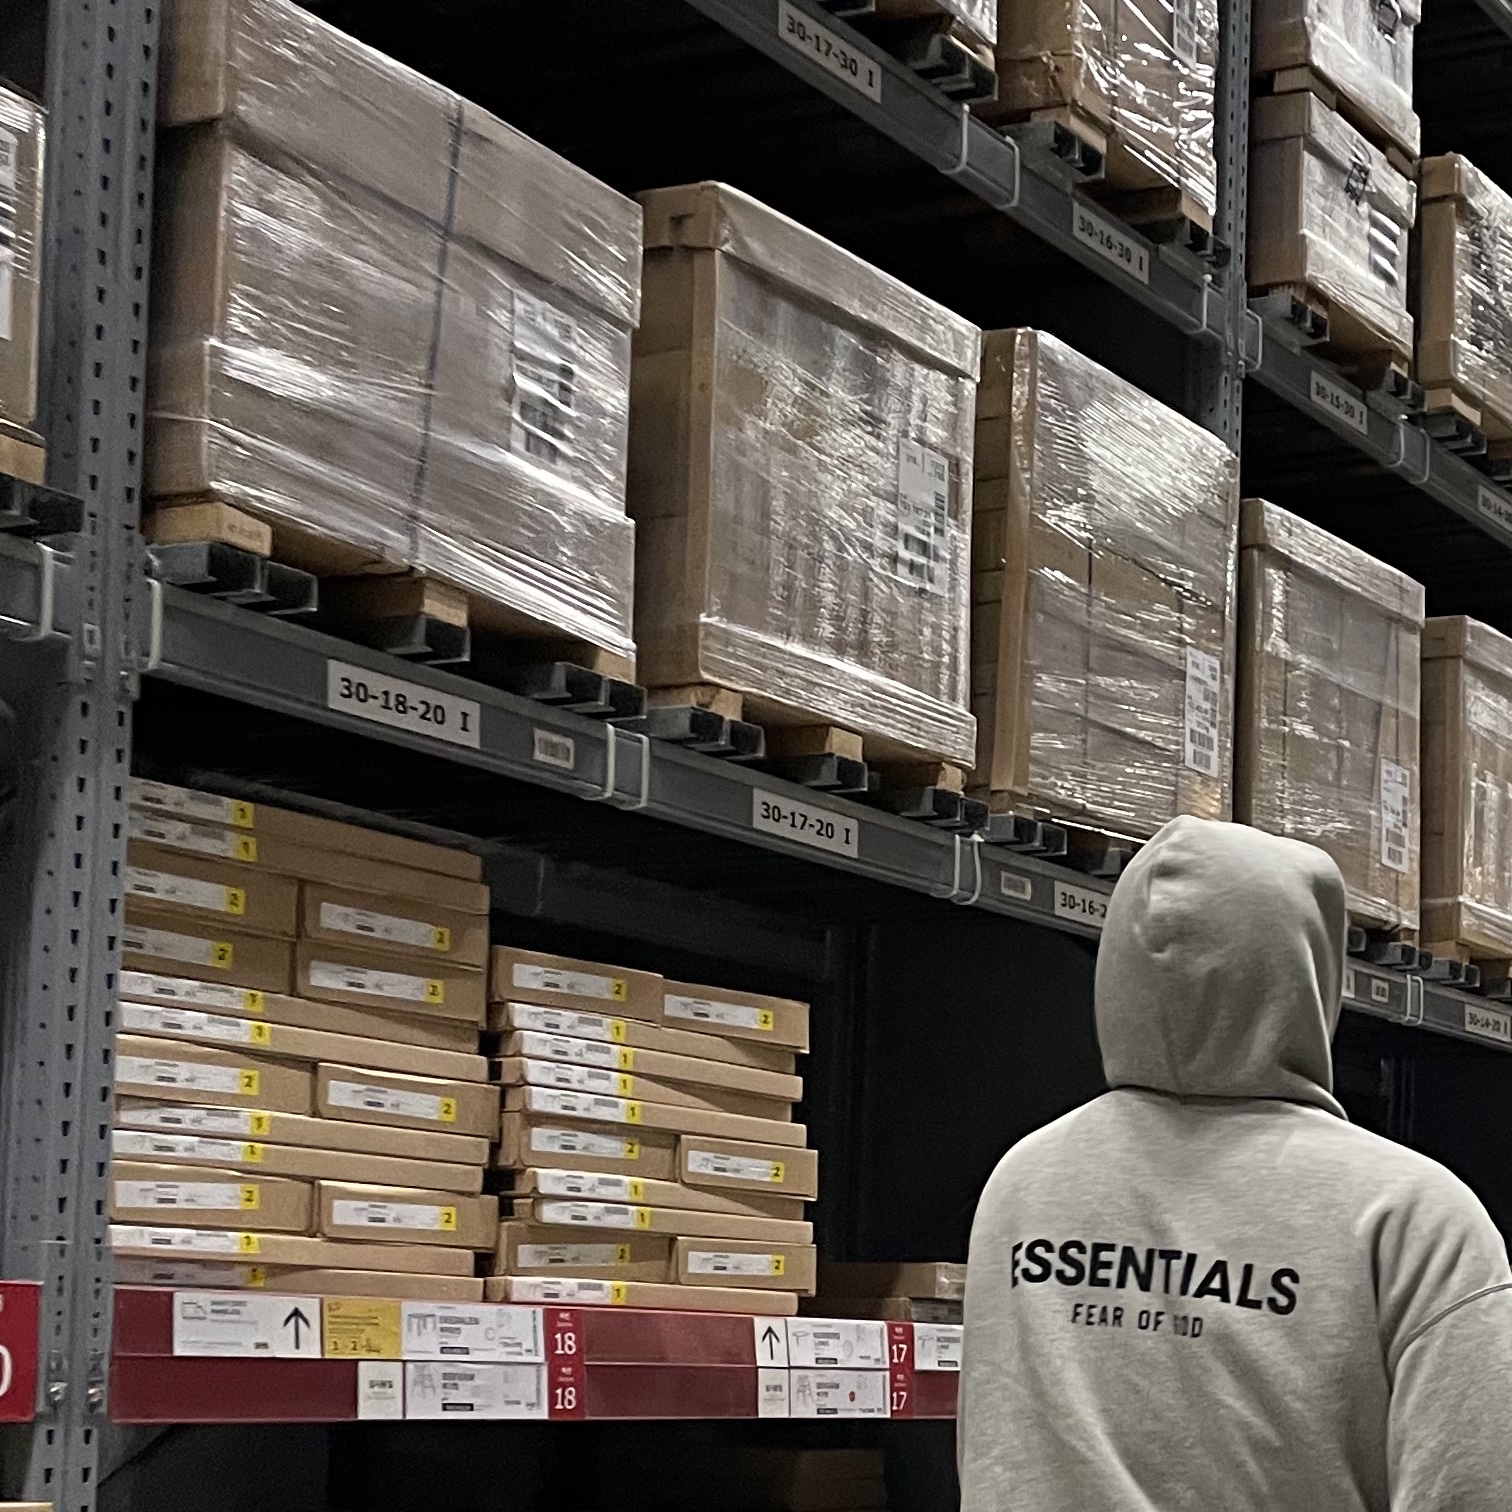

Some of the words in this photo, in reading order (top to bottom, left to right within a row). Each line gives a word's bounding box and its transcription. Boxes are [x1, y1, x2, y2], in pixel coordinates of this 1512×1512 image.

[786, 16, 858, 77] 30-17-30
[1076, 214, 1132, 263] 30-16-30
[339, 677, 446, 725] 30-18-20
[460, 711, 470, 732] I
[760, 801, 835, 840] 30-17-20
[842, 827, 851, 845] I
[1071, 1303, 1124, 1328] FEAR
[1138, 1309, 1165, 1332] OF
[554, 1332, 577, 1355] 18
[892, 1344, 908, 1363] 17
[554, 1386, 577, 1410] 18
[892, 1391, 907, 1411] 17
